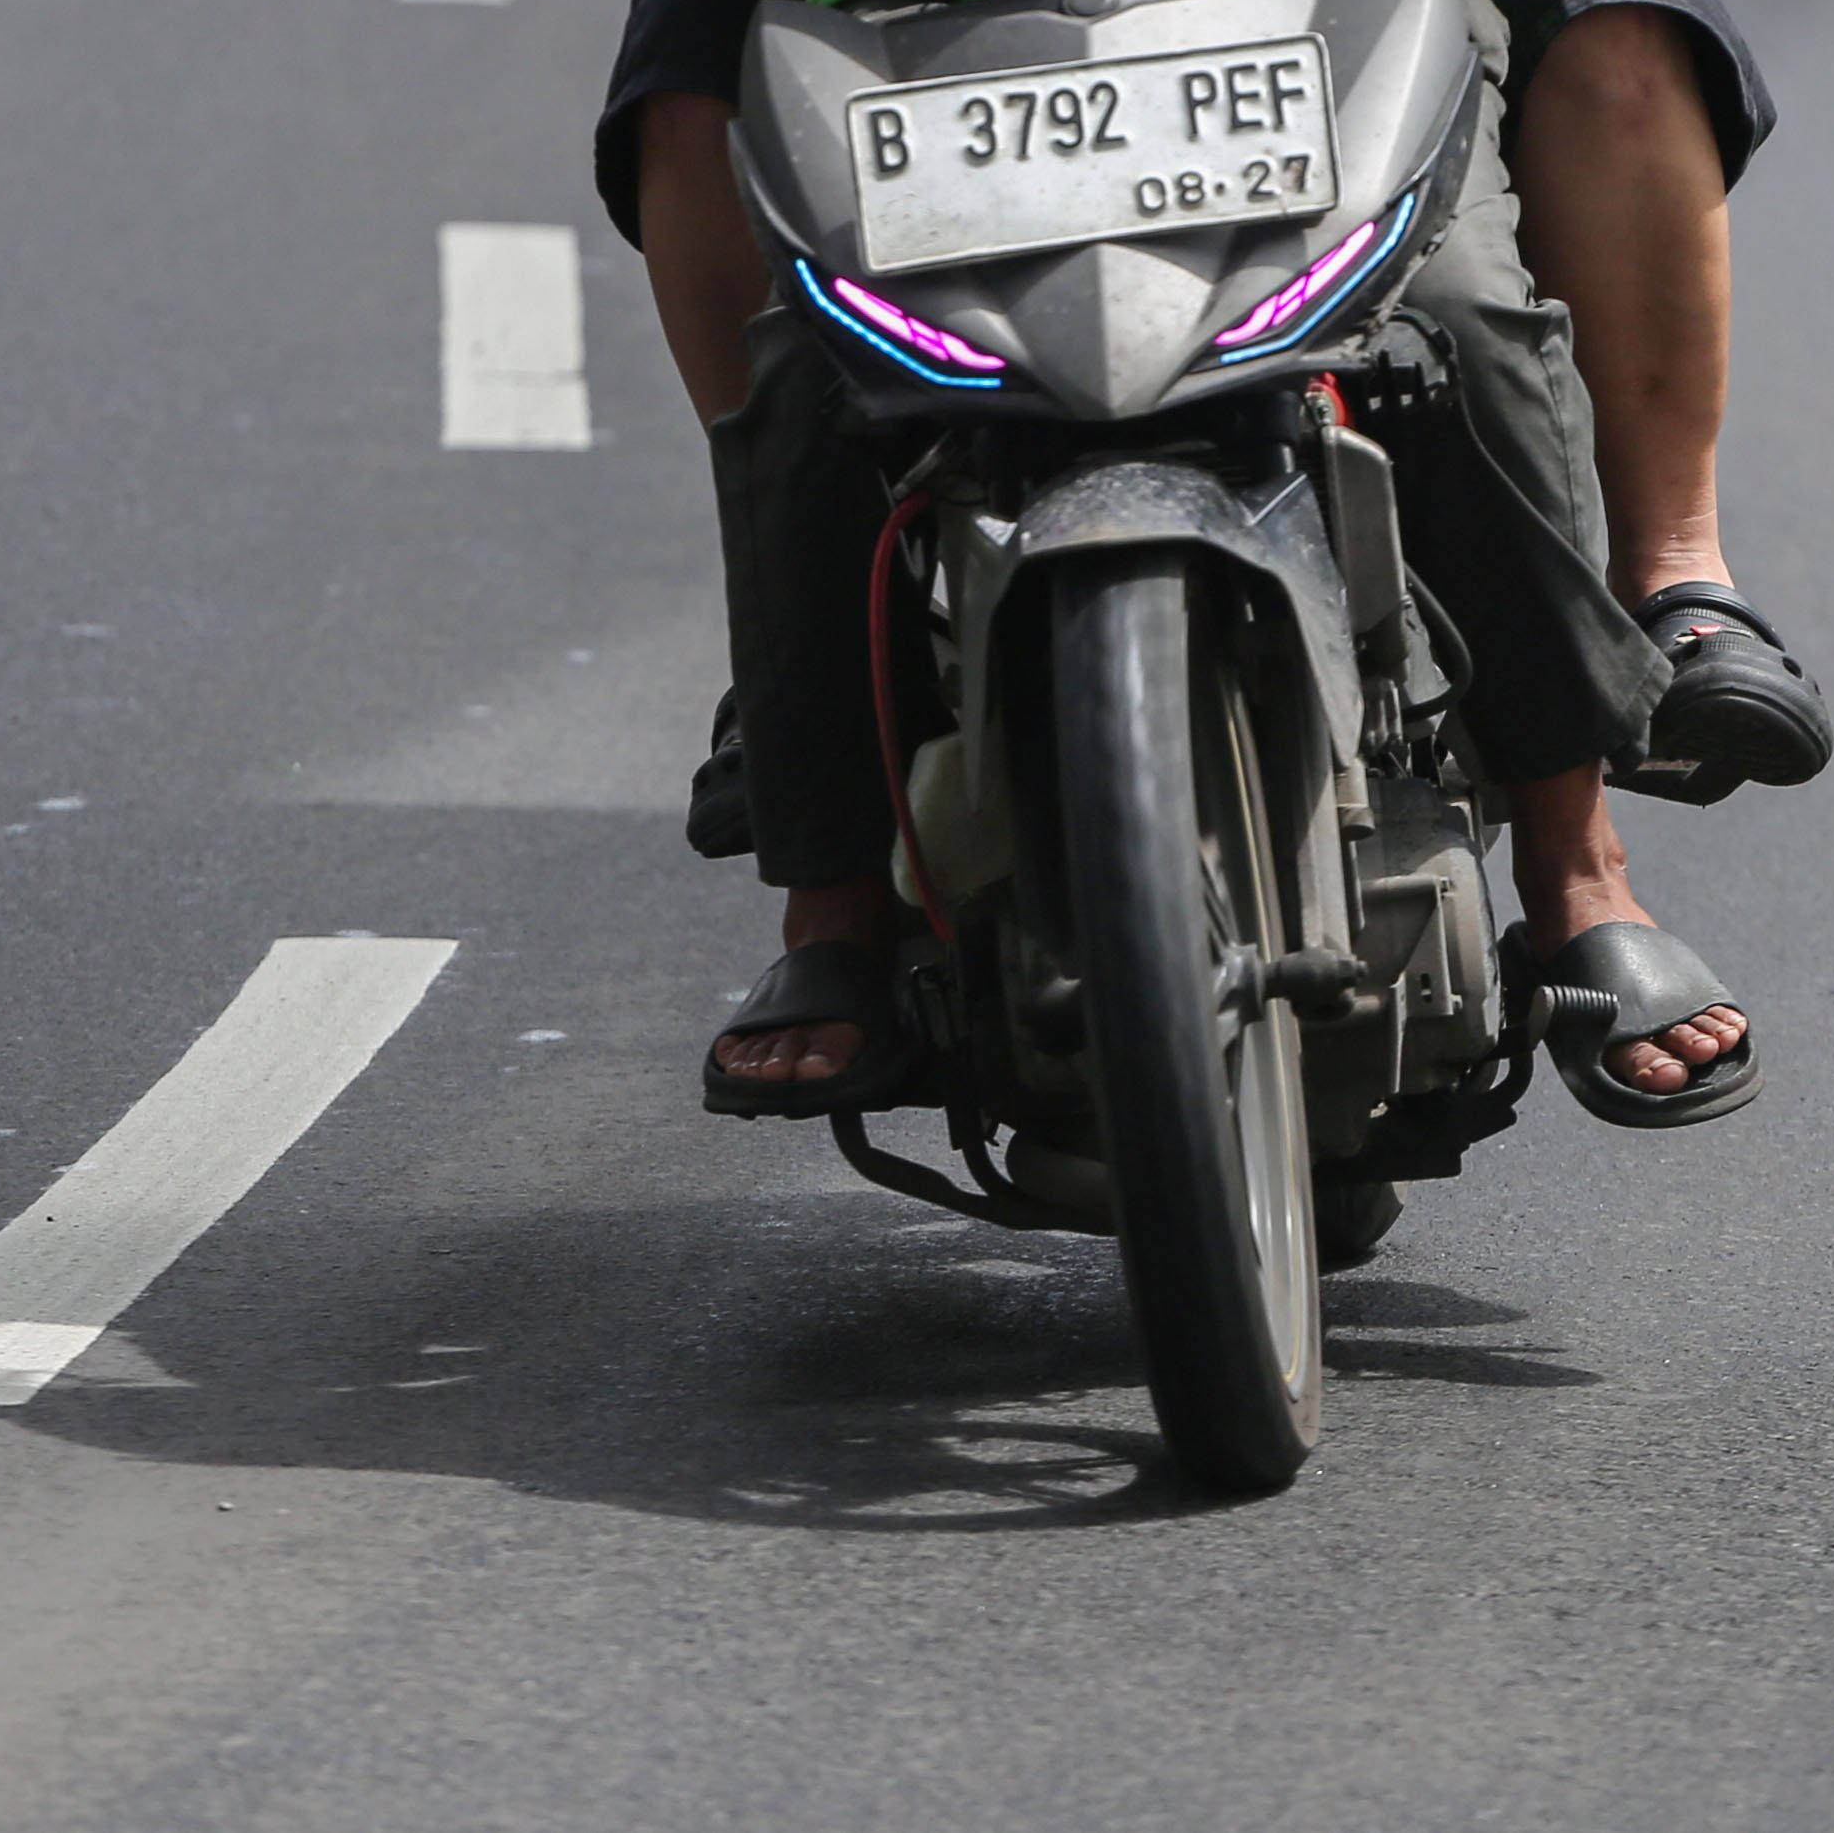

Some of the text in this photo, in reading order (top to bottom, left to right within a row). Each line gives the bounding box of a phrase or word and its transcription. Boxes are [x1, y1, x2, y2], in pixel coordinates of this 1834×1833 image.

[869, 59, 1307, 175] B 3792 PEF
